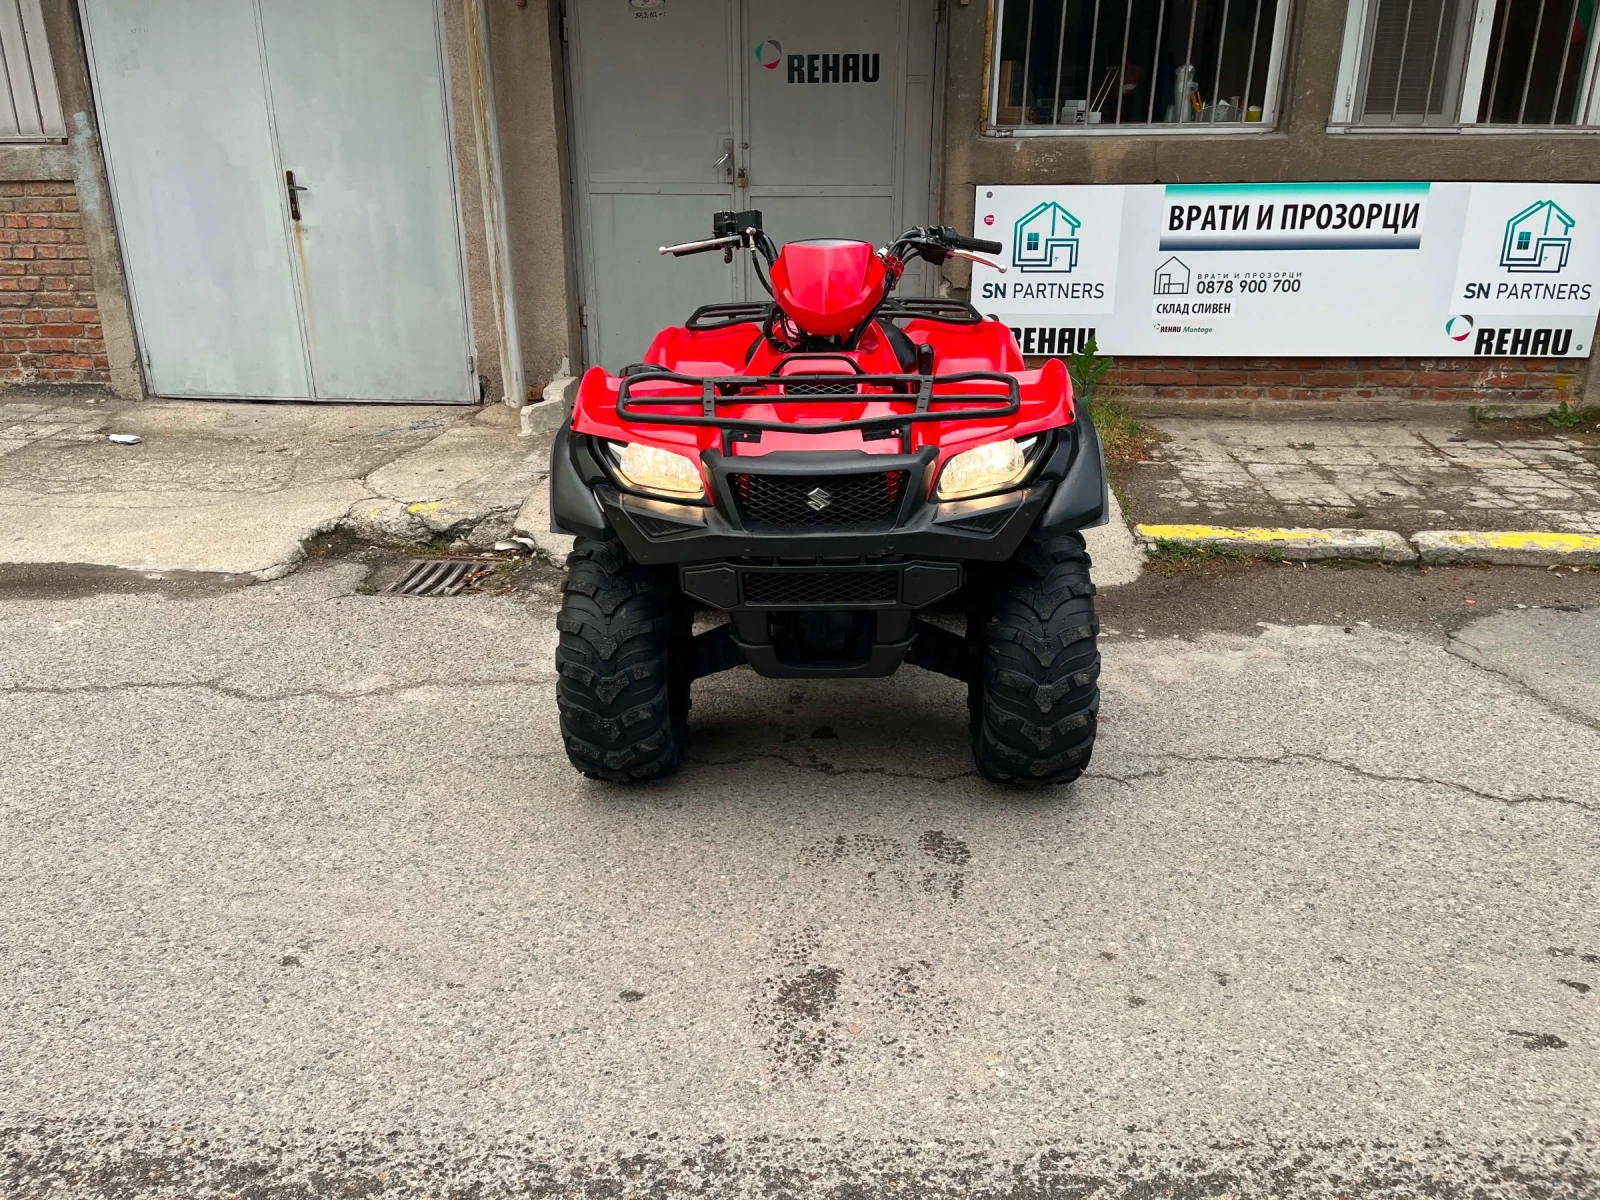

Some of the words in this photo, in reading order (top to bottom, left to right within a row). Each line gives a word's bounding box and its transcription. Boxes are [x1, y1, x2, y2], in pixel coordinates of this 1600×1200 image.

[787, 53, 880, 83] REHAU
[1168, 204, 1250, 231] ВРАТИ
[1256, 204, 1275, 231] И
[1280, 203, 1421, 234] ПРОЗОРЦИ
[1244, 271, 1303, 279] ПРОЗОРЦИ
[981, 282, 1007, 299] SN
[1013, 282, 1105, 299] PARTNERS
[1196, 280, 1234, 294] 0878
[1239, 280, 1268, 293] 900
[1272, 279, 1301, 293] 700
[1463, 282, 1492, 300] SN
[1496, 283, 1593, 300] PARTNERS
[1156, 303, 1190, 316] СКЛАД
[1191, 303, 1231, 314] СЛИВЕН
[1182, 326, 1213, 335] Montage
[1473, 328, 1573, 356] REHAU
